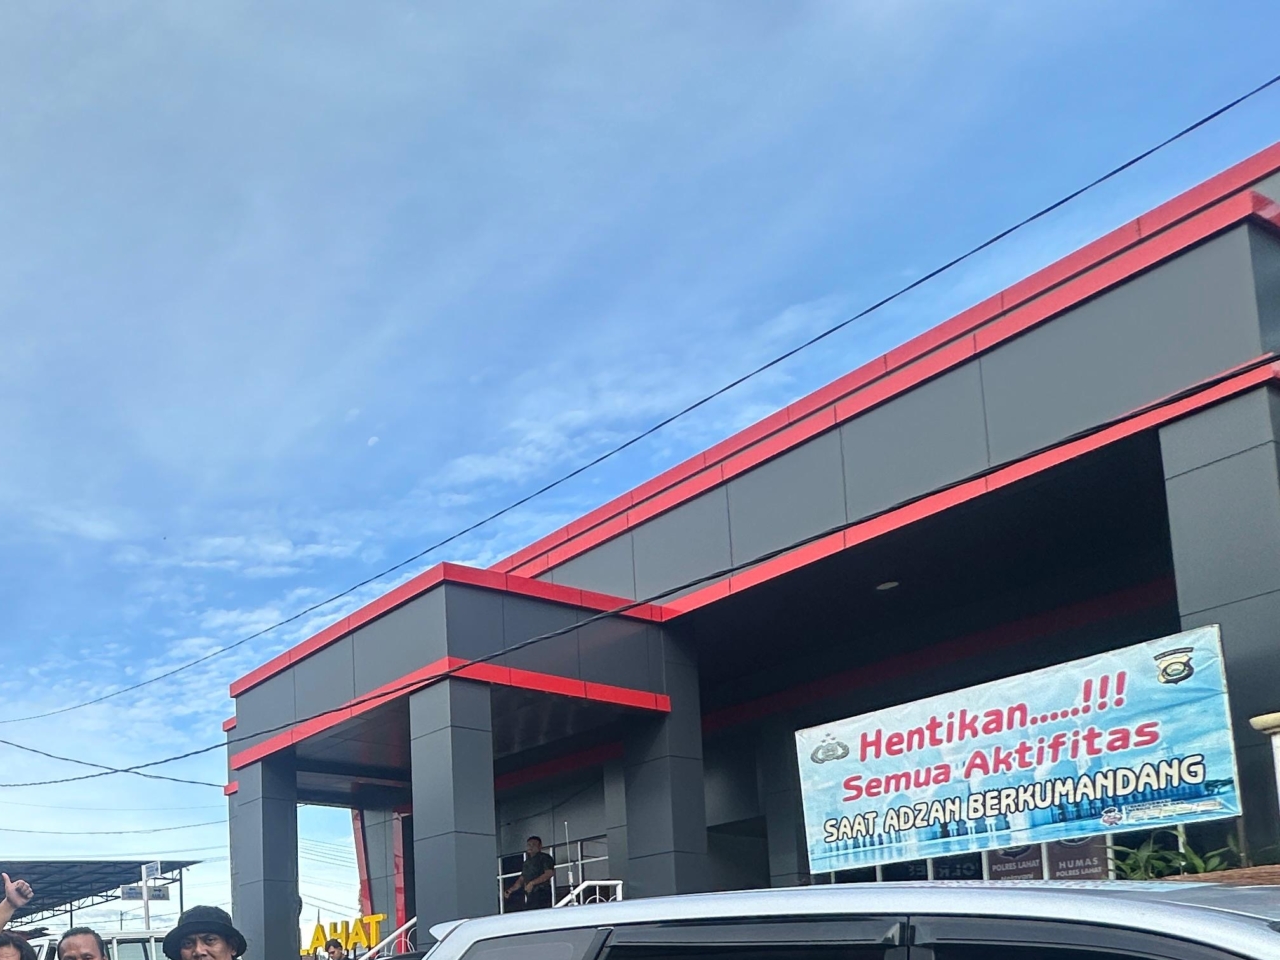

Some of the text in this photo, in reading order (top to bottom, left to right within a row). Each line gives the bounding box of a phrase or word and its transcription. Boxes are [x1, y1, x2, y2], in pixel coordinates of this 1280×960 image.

[842, 721, 1160, 802] Semua Aktifitas
[824, 753, 1205, 843] SAAT ADZAN BERKUMANDANG
[992, 860, 1040, 872] POLRES LAHAT
[1058, 857, 1099, 869] HUMAS
[1055, 866, 1102, 877] POLRES LAHAT
